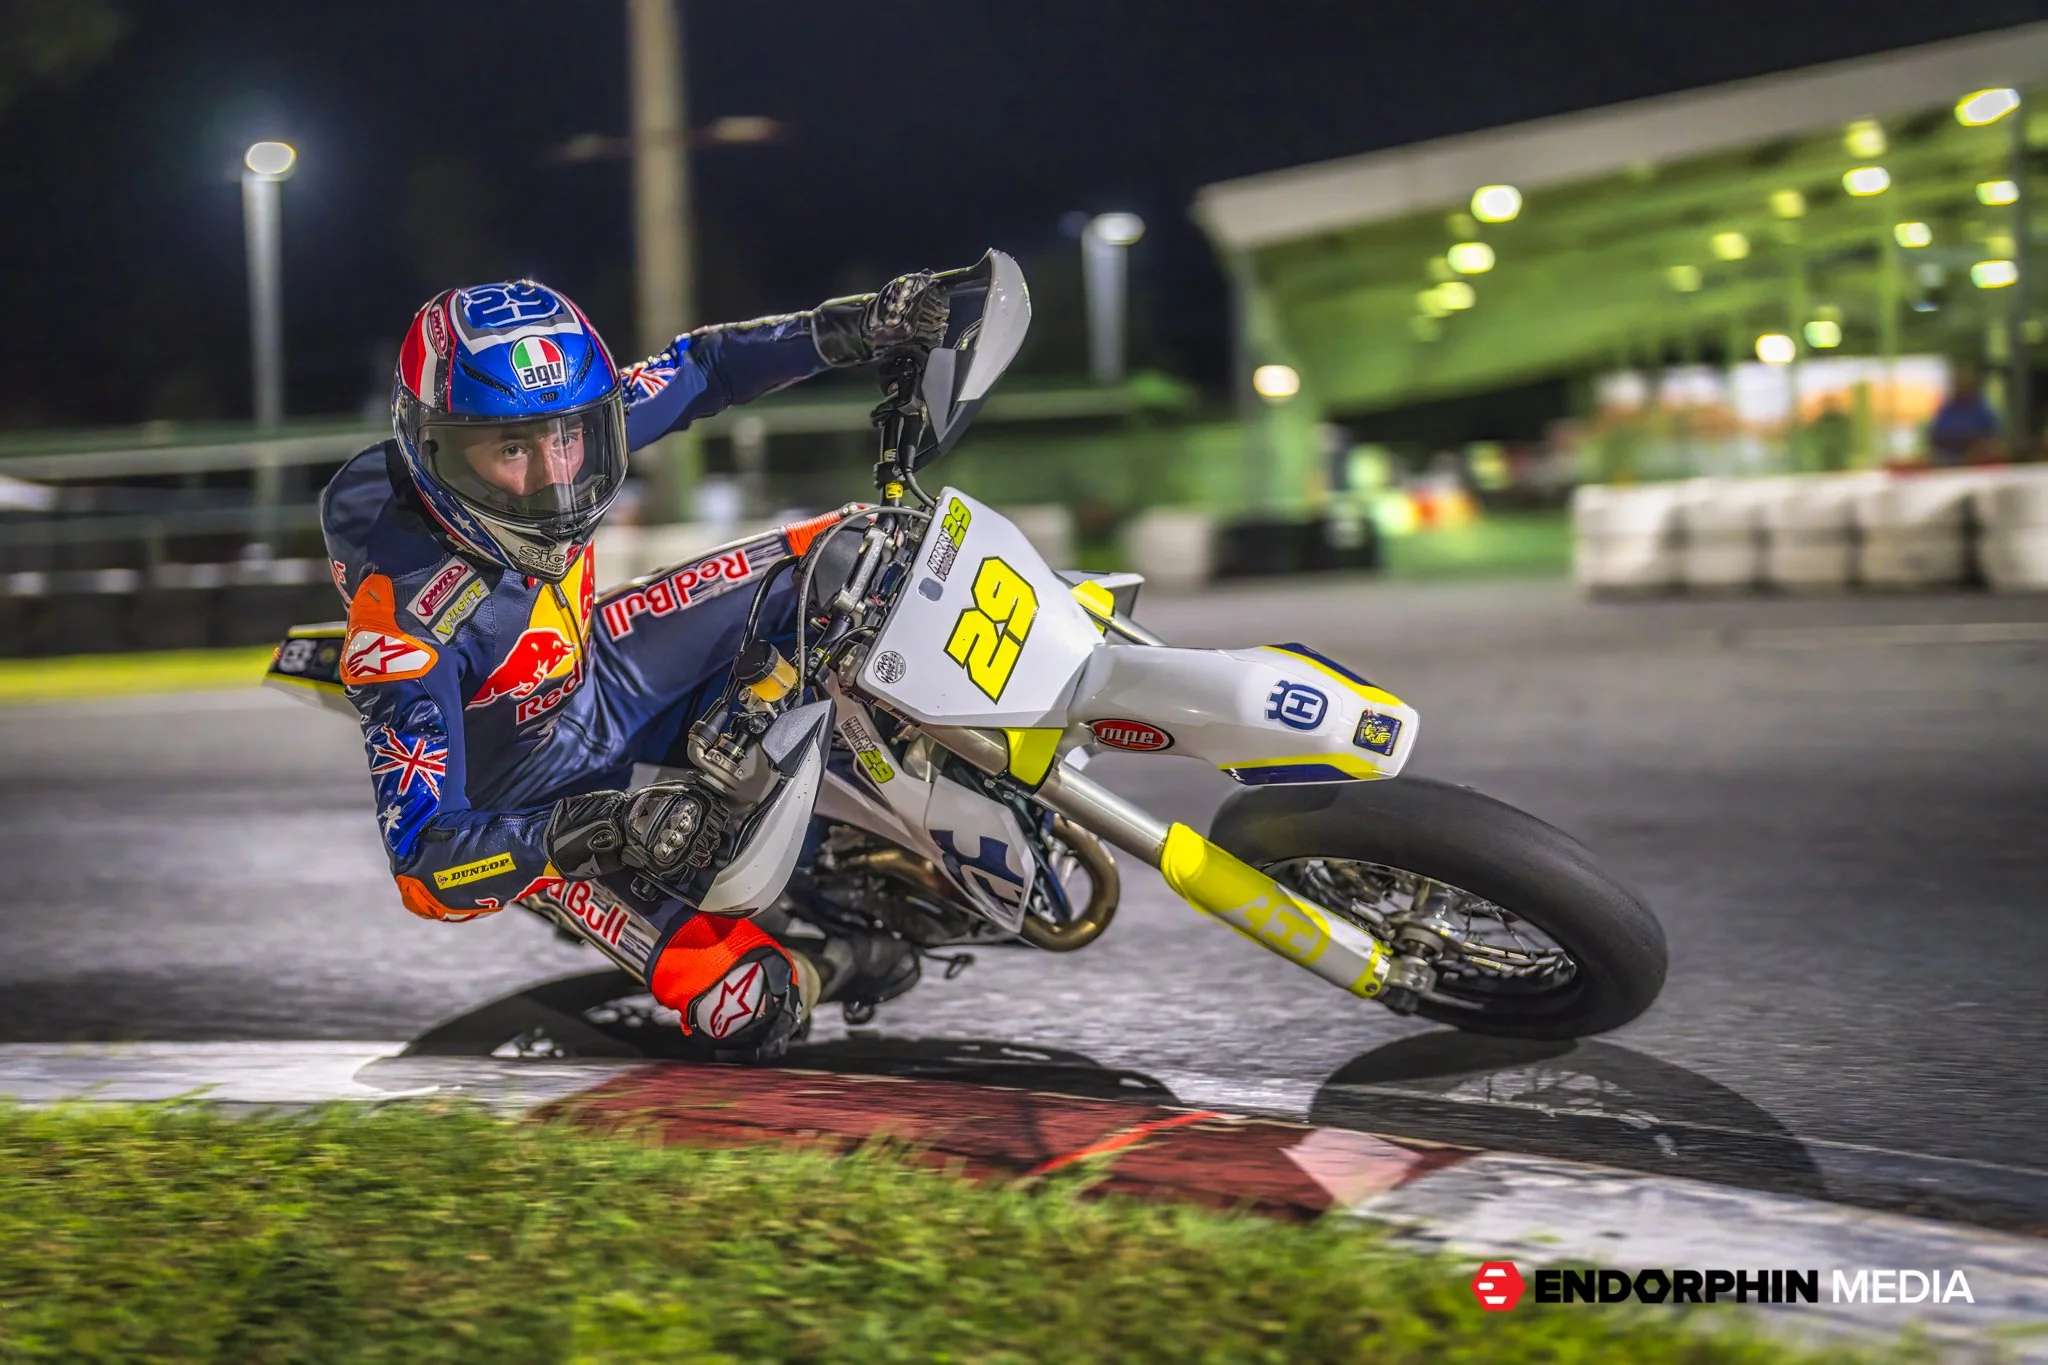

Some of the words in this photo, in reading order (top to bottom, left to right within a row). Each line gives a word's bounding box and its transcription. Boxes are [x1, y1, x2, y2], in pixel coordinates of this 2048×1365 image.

[463, 281, 561, 329] 29
[523, 362, 562, 386] agv
[942, 497, 971, 548] 29
[419, 571, 454, 616] PWR
[673, 549, 751, 609] Red
[602, 578, 677, 642] Bull
[943, 556, 1040, 705] 29
[516, 659, 582, 725] Red
[1101, 727, 1156, 745] mpe
[858, 749, 895, 783] 29
[451, 858, 510, 881] DUNLOP
[565, 881, 629, 946] Bull
